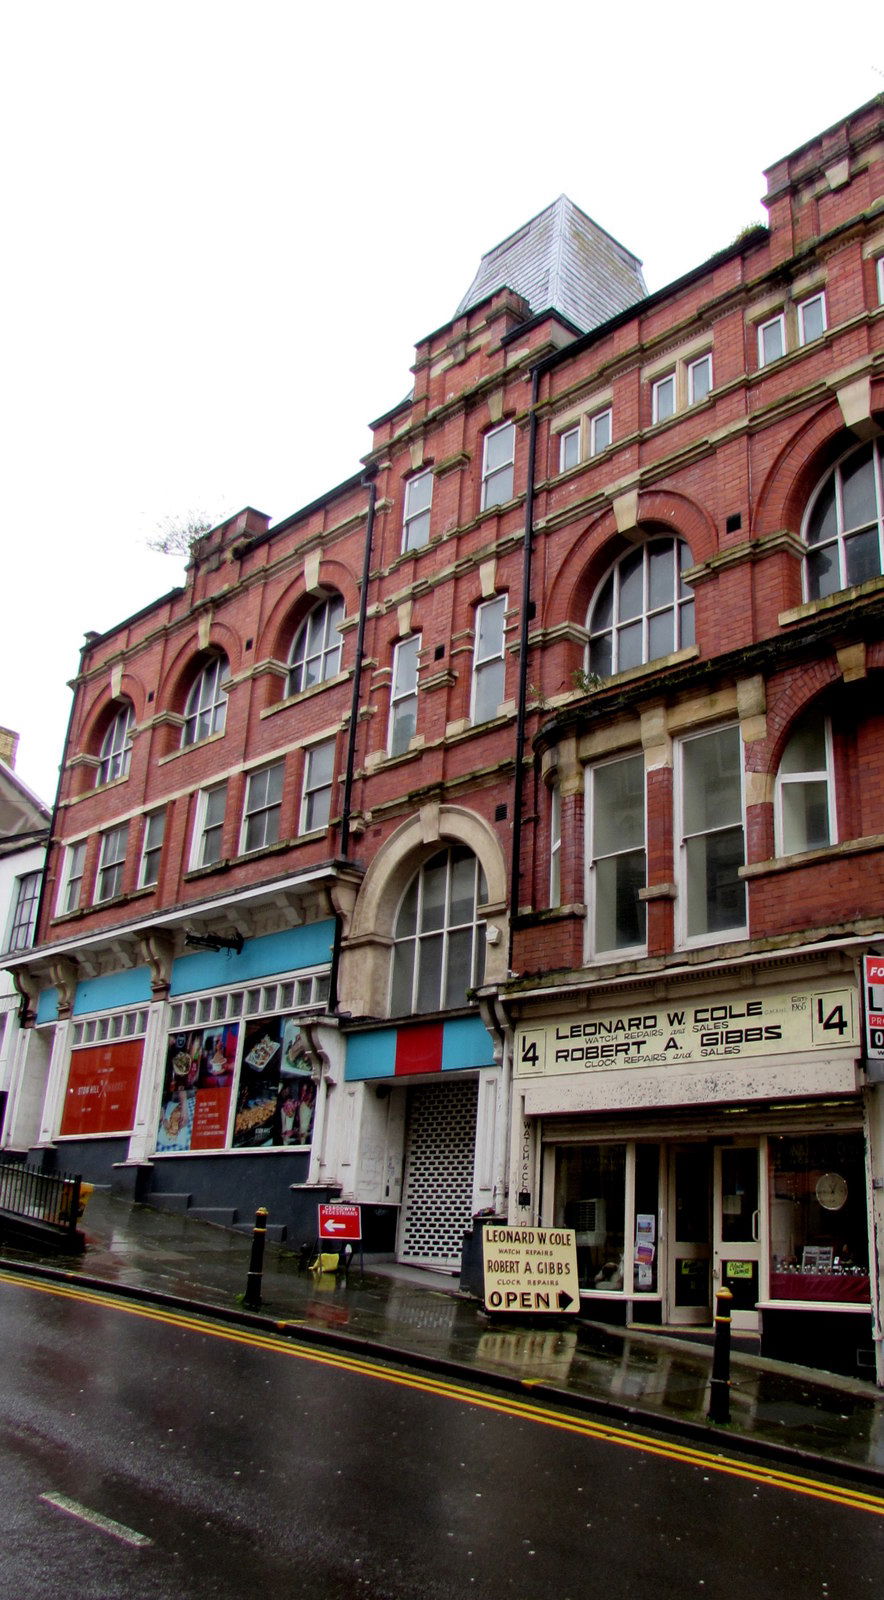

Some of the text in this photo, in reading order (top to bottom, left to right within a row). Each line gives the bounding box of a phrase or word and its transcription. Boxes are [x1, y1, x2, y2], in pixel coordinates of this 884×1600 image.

[556, 1001, 763, 1040] LEONARD W. COLE
[817, 998, 848, 1036] 14
[555, 1024, 782, 1063] ROBERT A. GIBBS
[584, 1021, 729, 1045] WATCH REPAIRS and SALES
[521, 1035, 539, 1067] 14
[584, 1045, 741, 1069] CLOCK REPAIRS and SALES
[522, 1121, 530, 1161] WATCH
[486, 1229, 534, 1244] LEONARD
[549, 1233, 571, 1246] COLE
[487, 1260, 520, 1273] ROBERT
[537, 1262, 571, 1275] GIBBS
[489, 1291, 550, 1309] OPEN
